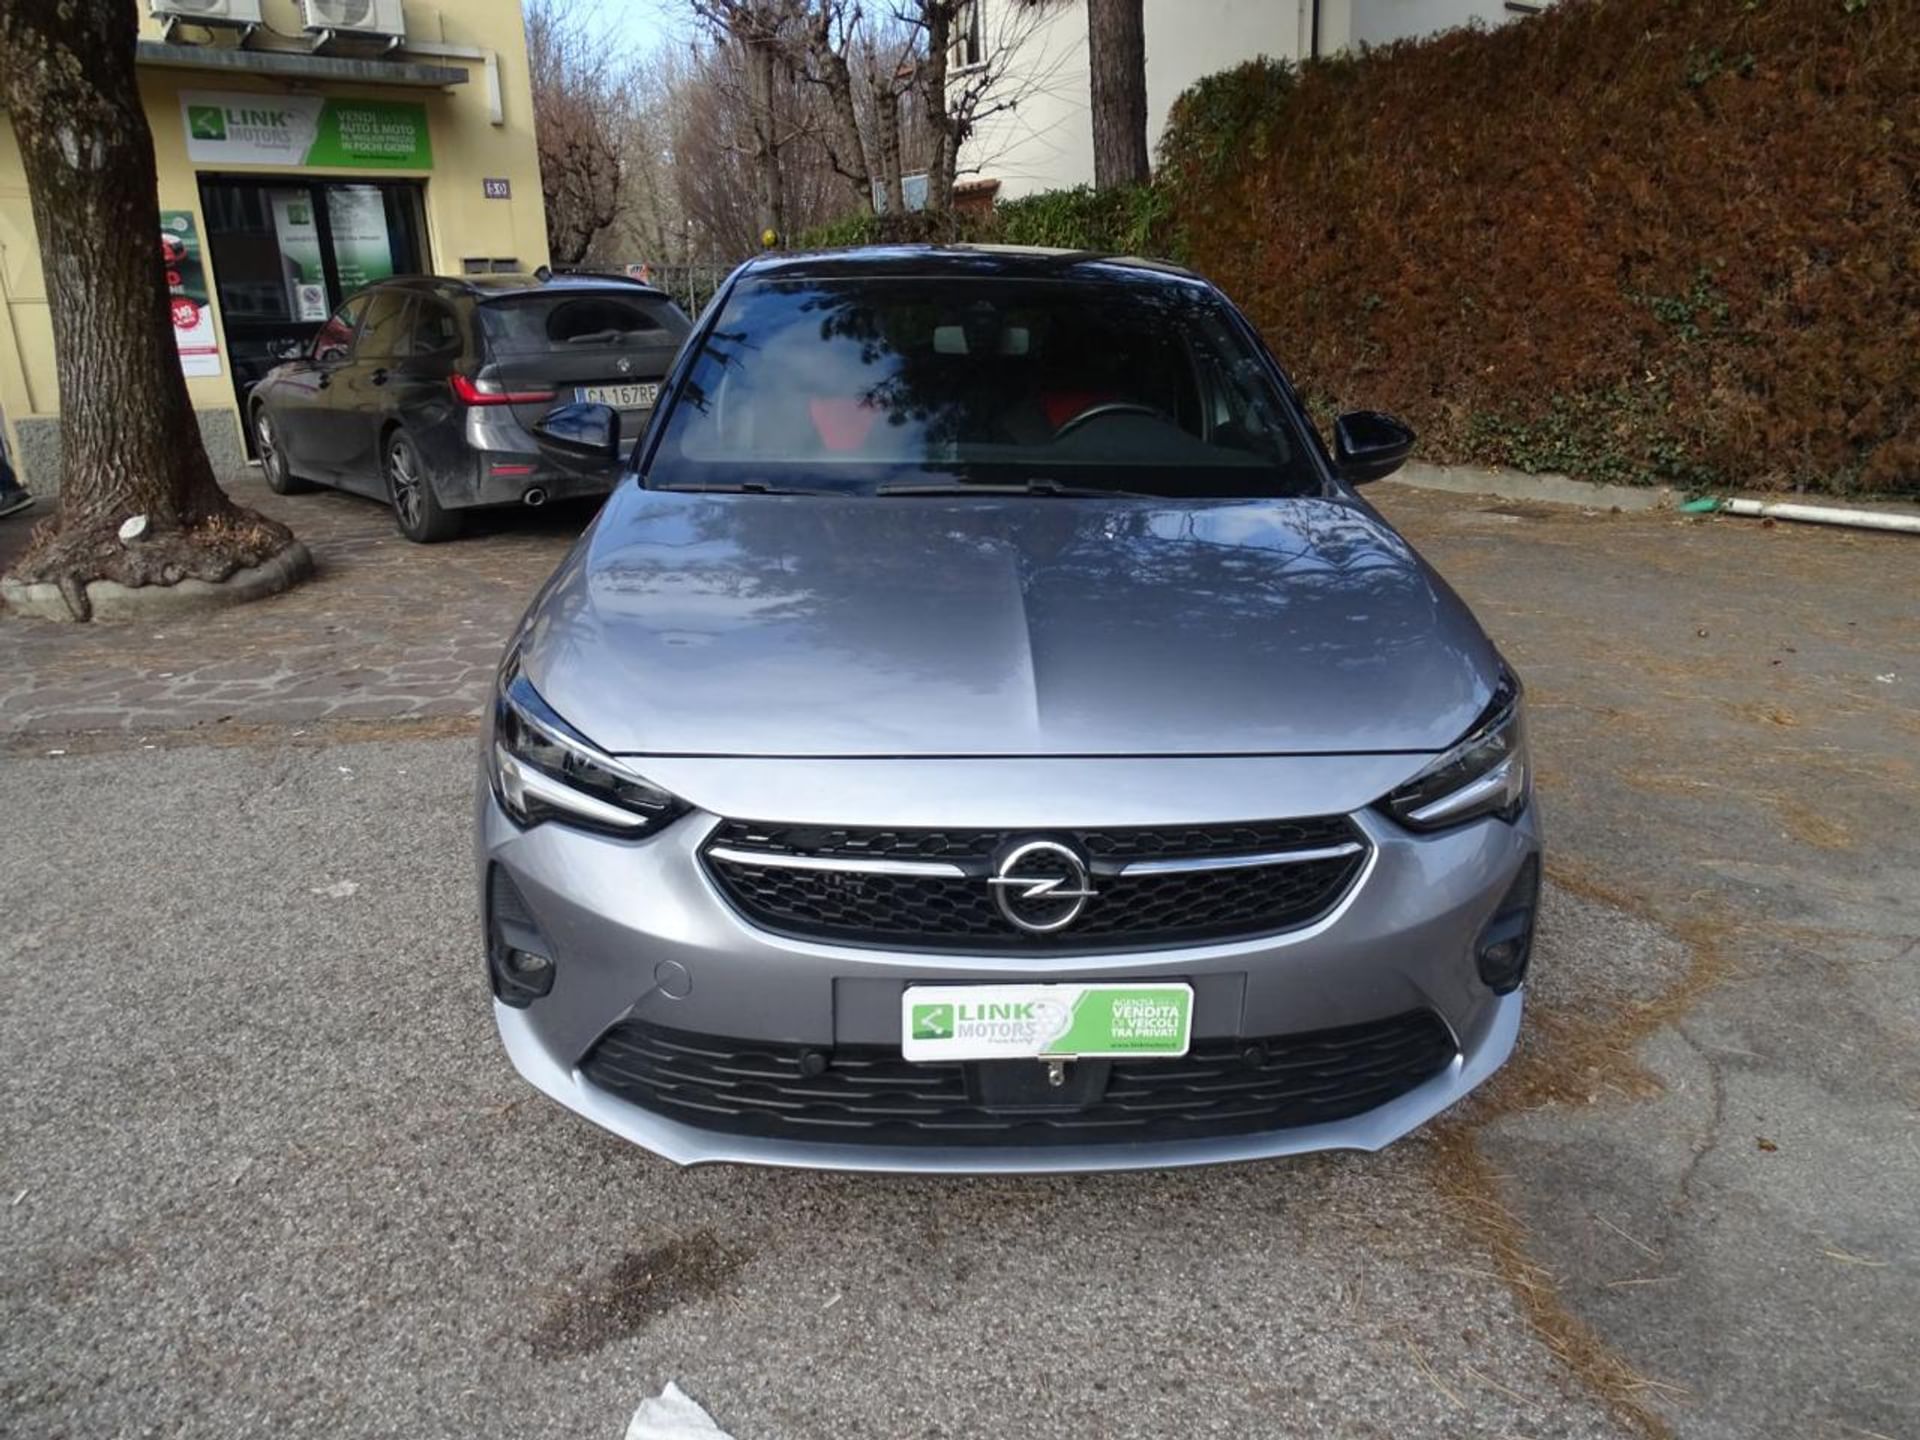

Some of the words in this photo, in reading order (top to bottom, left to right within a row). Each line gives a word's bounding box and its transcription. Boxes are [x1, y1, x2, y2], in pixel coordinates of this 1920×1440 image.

[226, 109, 287, 128] LINK
[229, 128, 290, 143] MOTORS
[339, 122, 370, 133] AUTO
[382, 124, 415, 135] MOTO
[958, 1003, 1035, 1021] LINK
[1112, 1006, 1179, 1018] VENDITA
[958, 1022, 1036, 1038] MOTORS
[1127, 1018, 1178, 1028] VEICOLI
[1111, 1028, 1133, 1037] TRA
[1135, 1028, 1177, 1037] PRIVATI
